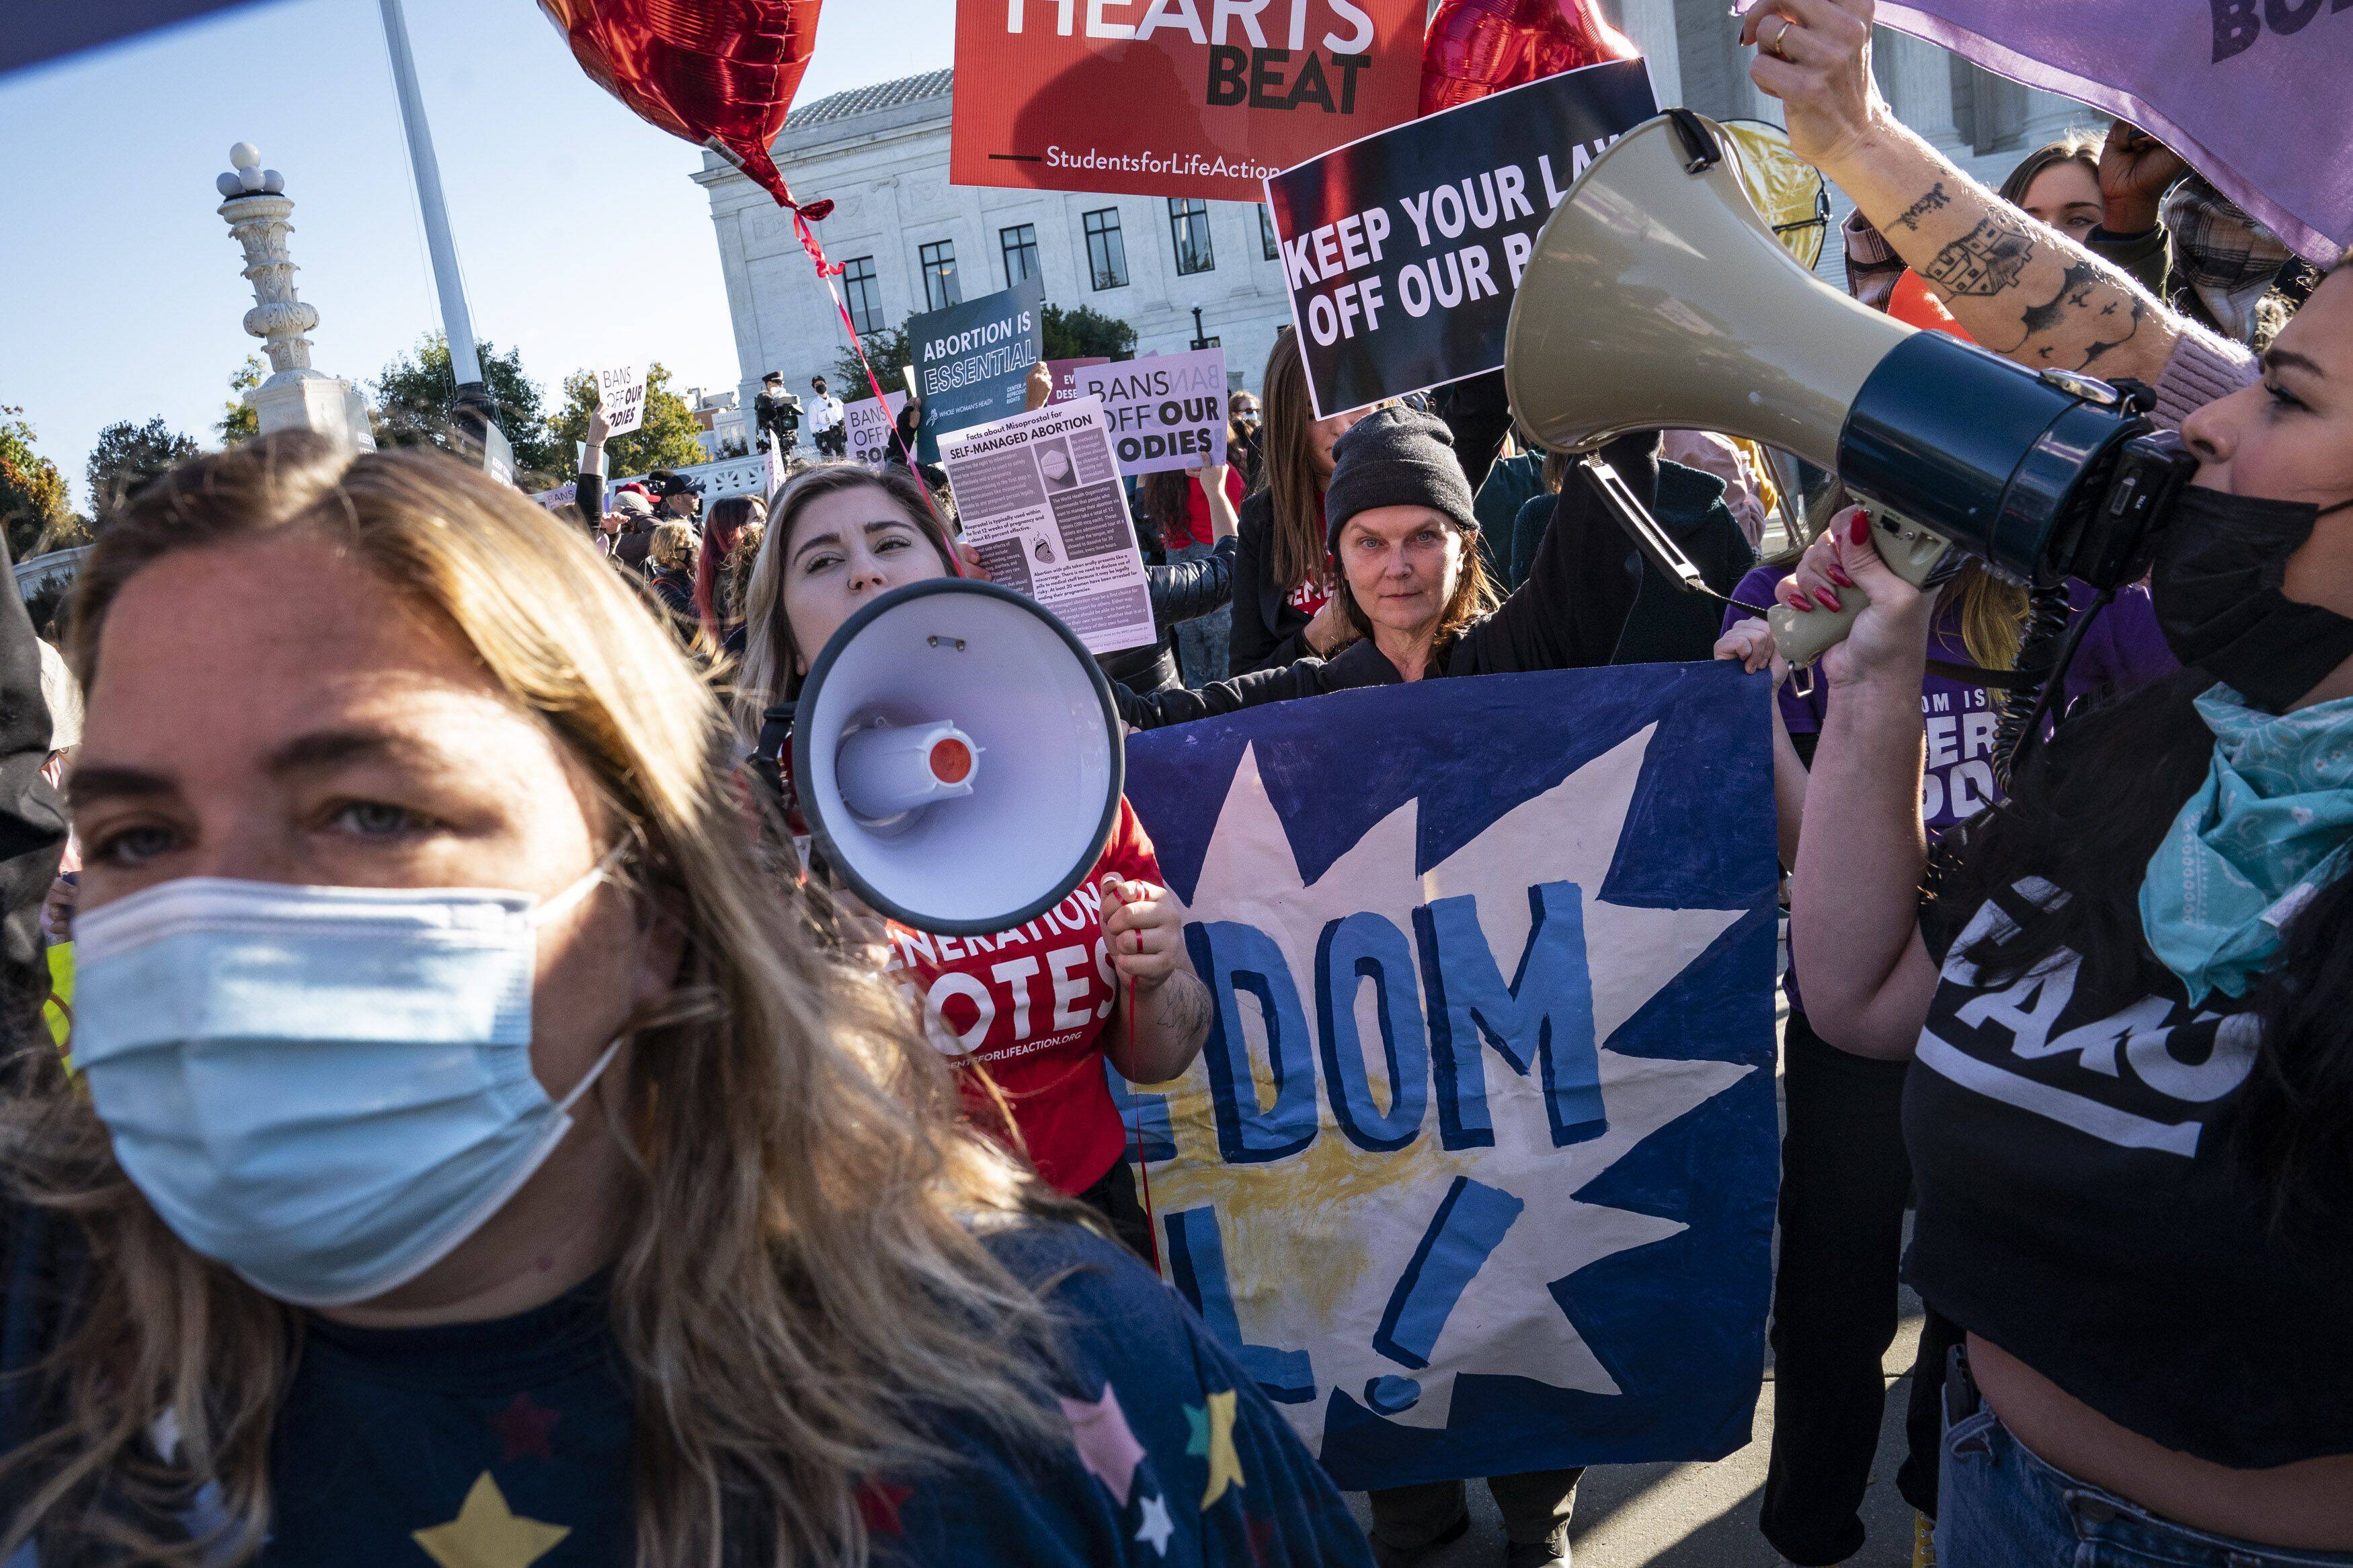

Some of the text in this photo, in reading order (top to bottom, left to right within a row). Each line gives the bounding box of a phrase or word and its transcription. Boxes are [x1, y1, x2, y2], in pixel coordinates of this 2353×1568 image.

[2210, 0, 2353, 65] BO
[1206, 44, 1371, 114] BEAT
[1283, 207, 1390, 290] KEEP
[1400, 165, 1535, 247] YOUR
[1308, 276, 1384, 347] OFF
[1398, 245, 1499, 317] OUR
[924, 311, 1031, 362] ABORTION IS
[604, 366, 631, 388] BANS
[924, 339, 1036, 395] ESSENTIAL
[625, 384, 643, 405] OUR
[1006, 395, 1021, 404] RIGHTS
[1088, 370, 1170, 403] BANS
[607, 407, 636, 427] ODIES
[850, 406, 887, 427] BANS
[939, 409, 955, 417] WHOLE
[978, 399, 993, 408] HEALTH
[1158, 397, 1220, 426] OUR
[854, 426, 883, 446] OFF
[949, 414, 1092, 459] SELF-MANAGED ABORTION
[966, 431, 982, 440] Facts
[984, 425, 1005, 436] about
[1005, 413, 1049, 430] Misoprostol
[1112, 427, 1213, 462] ODIES
[992, 515, 1013, 524] typically
[1009, 518, 1034, 528] pregnancy
[992, 530, 1009, 539] percent
[1064, 588, 1090, 596] pregnancies.
[1964, 689, 1985, 708] IS
[901, 936, 1119, 1055] OTES
[948, 1032, 1082, 1070] ENTFORLIFEACTION.ORG
